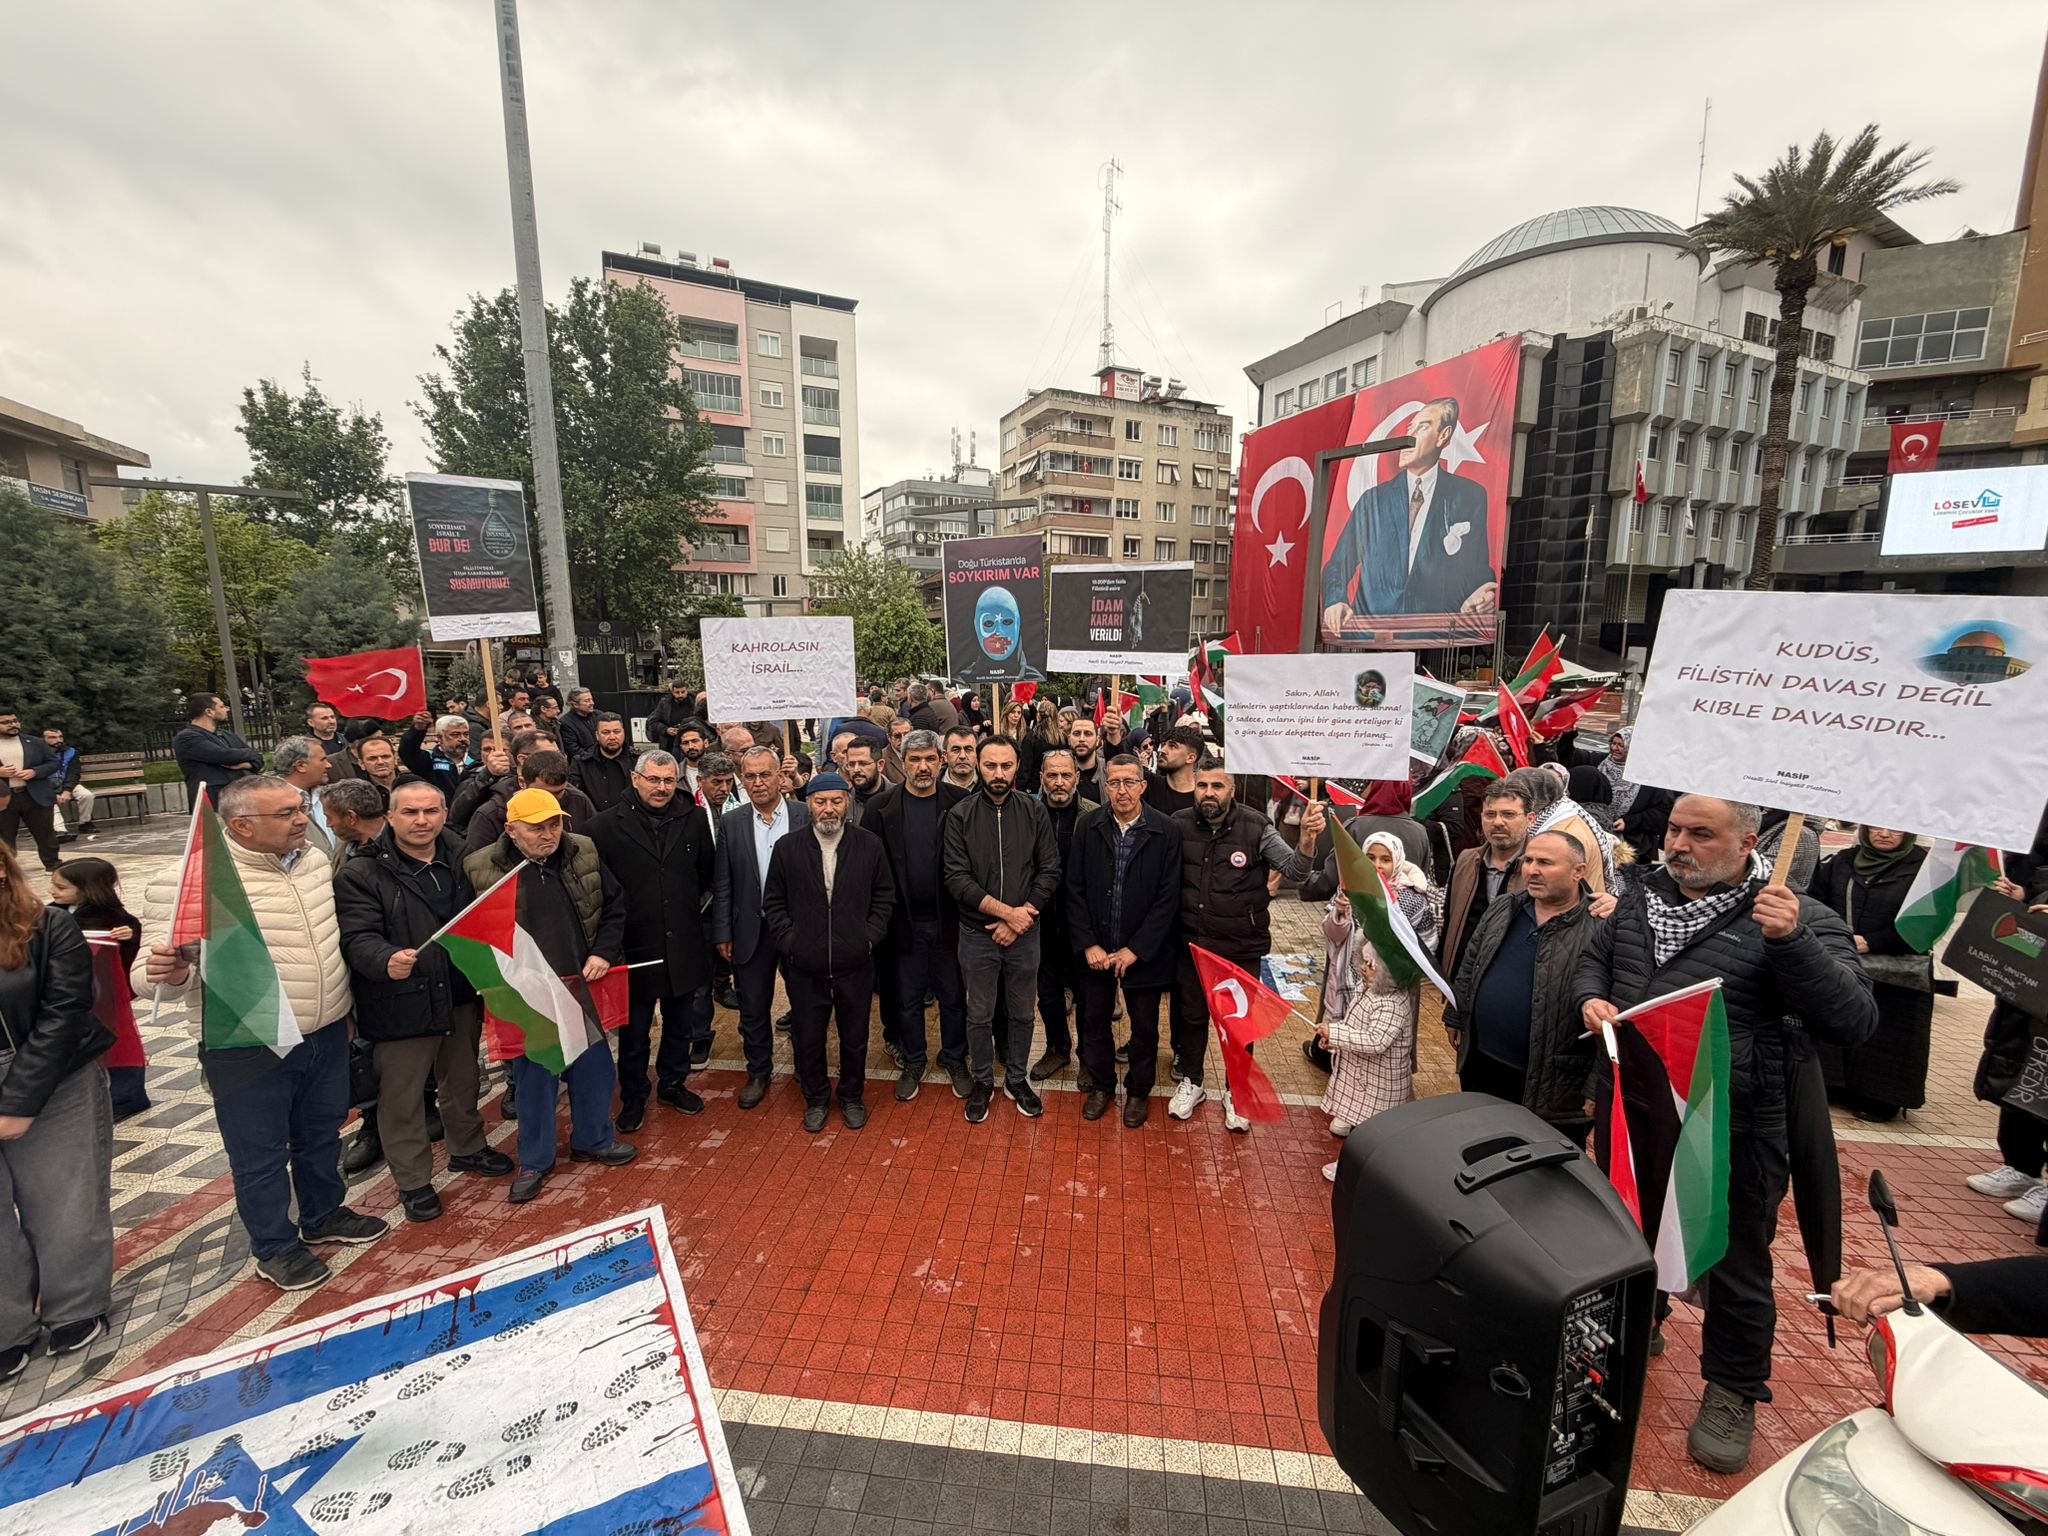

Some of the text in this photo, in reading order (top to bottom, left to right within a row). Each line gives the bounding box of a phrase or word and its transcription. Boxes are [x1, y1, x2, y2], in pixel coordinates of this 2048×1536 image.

[1934, 500, 1981, 510] LÖSEV
[428, 538, 471, 553] DUR DE!
[958, 556, 1026, 570] Doğu Türkistan'da
[949, 566, 1040, 584] SOYKIRIM VAR
[449, 577, 511, 590] SUSMUYORUZ!
[1091, 596, 1124, 612] İDAM
[1090, 614, 1123, 627] KARARI
[731, 641, 819, 654] KAHROLASIN
[1776, 641, 1879, 664] KUDÜS,
[751, 660, 804, 674] İSRAİL...
[1677, 664, 1992, 707] FİLİSTİN DAVASI DEĞİL
[1285, 689, 1340, 698] Sakın, Allah'ı
[1227, 702, 1267, 710] zalimlerin
[1269, 703, 1329, 712] yaptıklarından
[1236, 715, 1264, 724] sadece,
[1266, 715, 1295, 723] onların
[1298, 716, 1314, 725] işini
[1331, 717, 1352, 726] güne
[1354, 717, 1392, 727] erteliyor
[1394, 718, 1404, 726] ki
[1692, 698, 1945, 739] KIBLE DAVASIDIR...
[1241, 729, 1257, 738] gün
[1258, 729, 1283, 738] gözler
[1285, 729, 1325, 738] dehşetten
[1327, 730, 1351, 739] dışarı
[1776, 770, 1810, 780] NASİP
